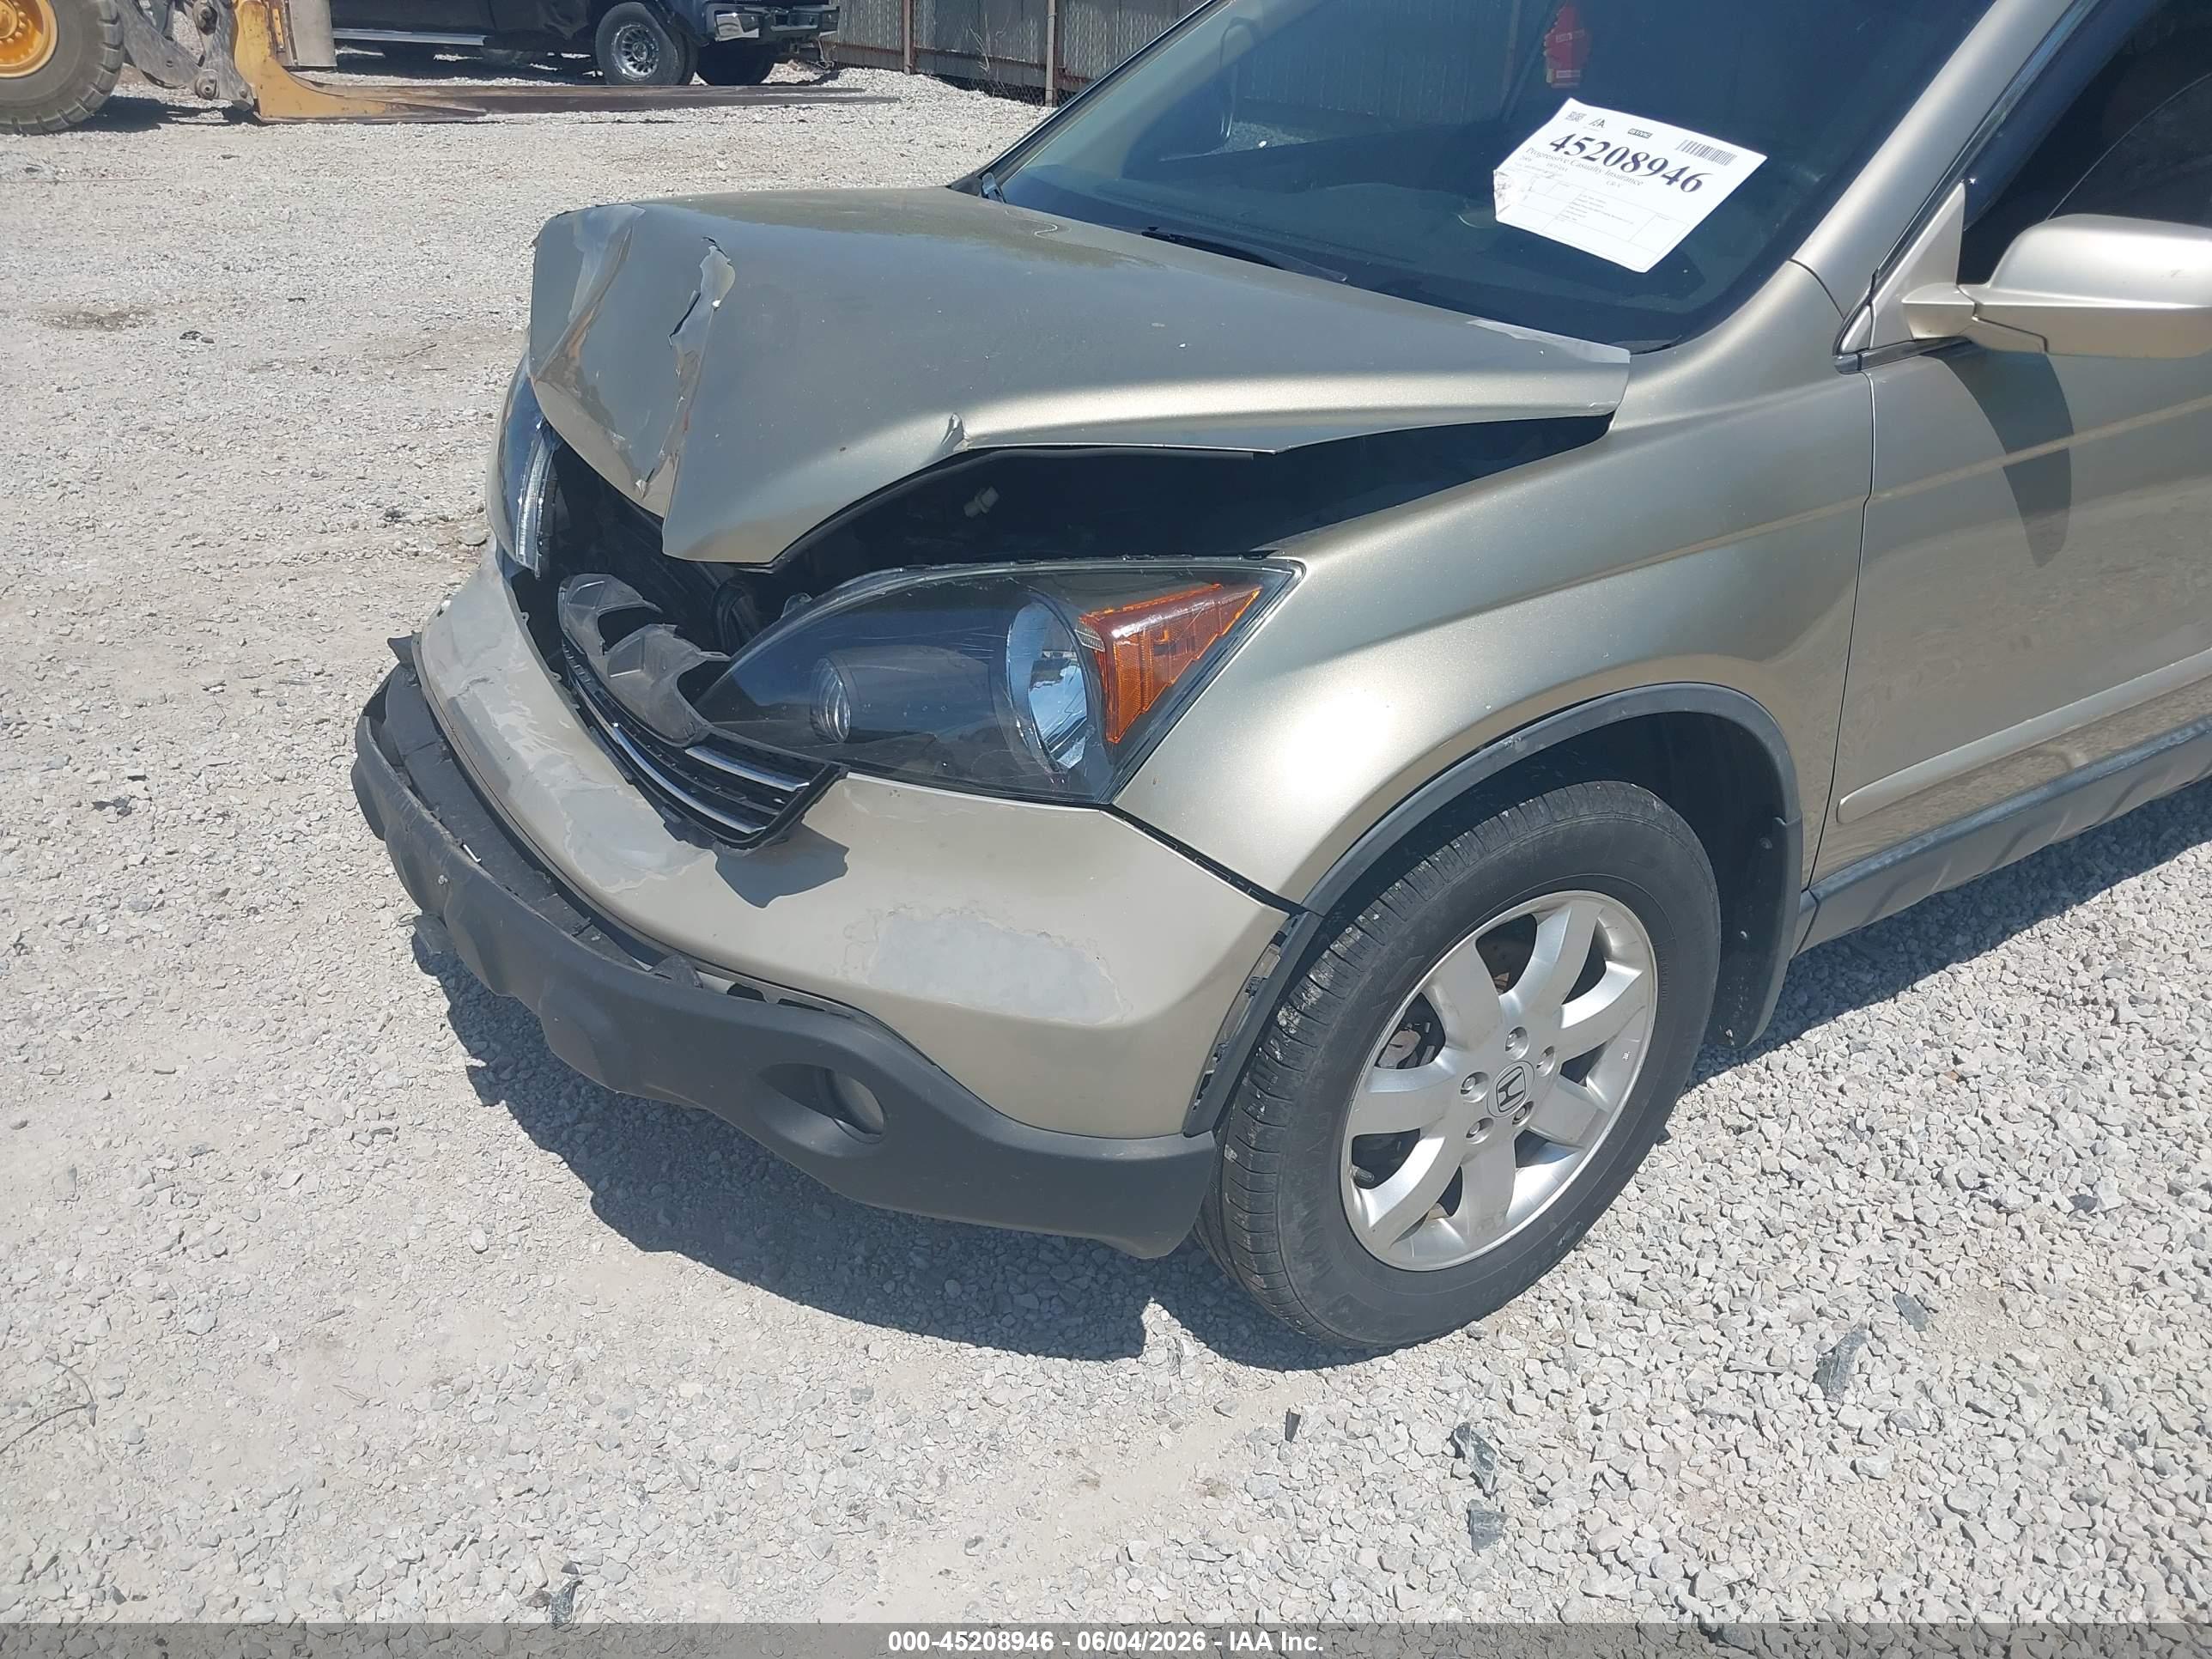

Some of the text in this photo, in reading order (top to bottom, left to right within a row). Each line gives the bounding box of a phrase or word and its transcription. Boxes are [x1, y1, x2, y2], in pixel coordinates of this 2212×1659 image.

[1525, 147, 1570, 164] Progressive
[1571, 159, 1604, 175] Casualty
[1604, 169, 1644, 186] Insurance
[1549, 132, 1712, 193] 45208946
